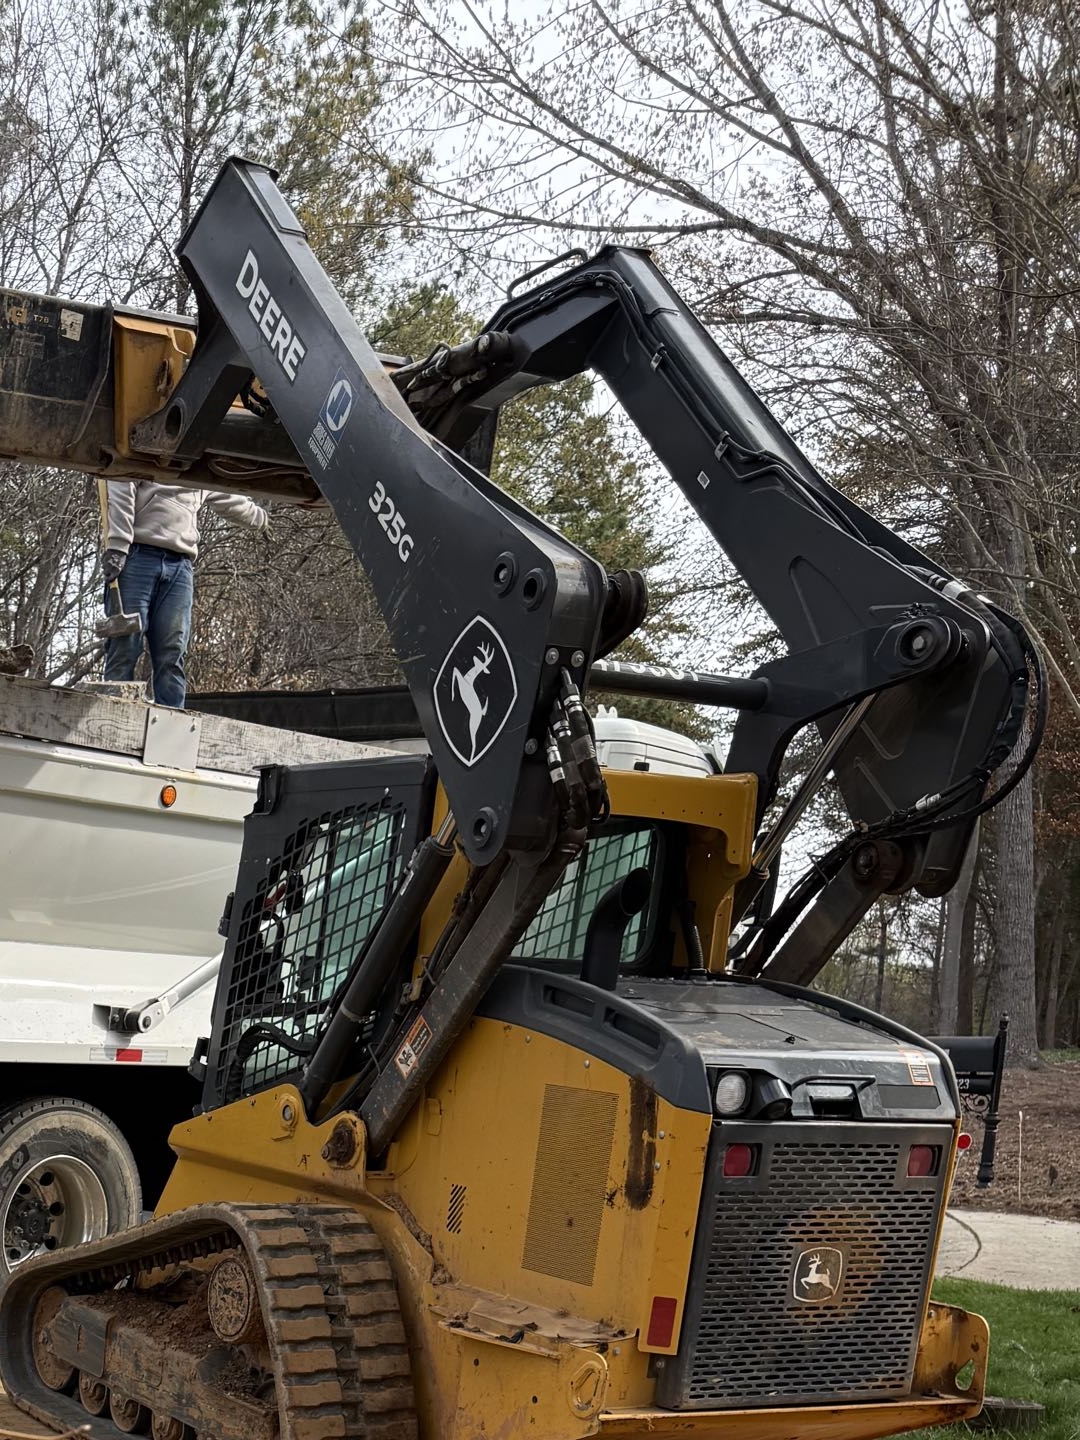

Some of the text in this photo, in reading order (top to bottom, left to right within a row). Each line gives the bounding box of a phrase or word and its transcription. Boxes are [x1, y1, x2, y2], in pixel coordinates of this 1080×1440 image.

[235, 248, 306, 381] DEERE
[368, 480, 415, 563] 325G
[956, 1079, 970, 1090] 23
